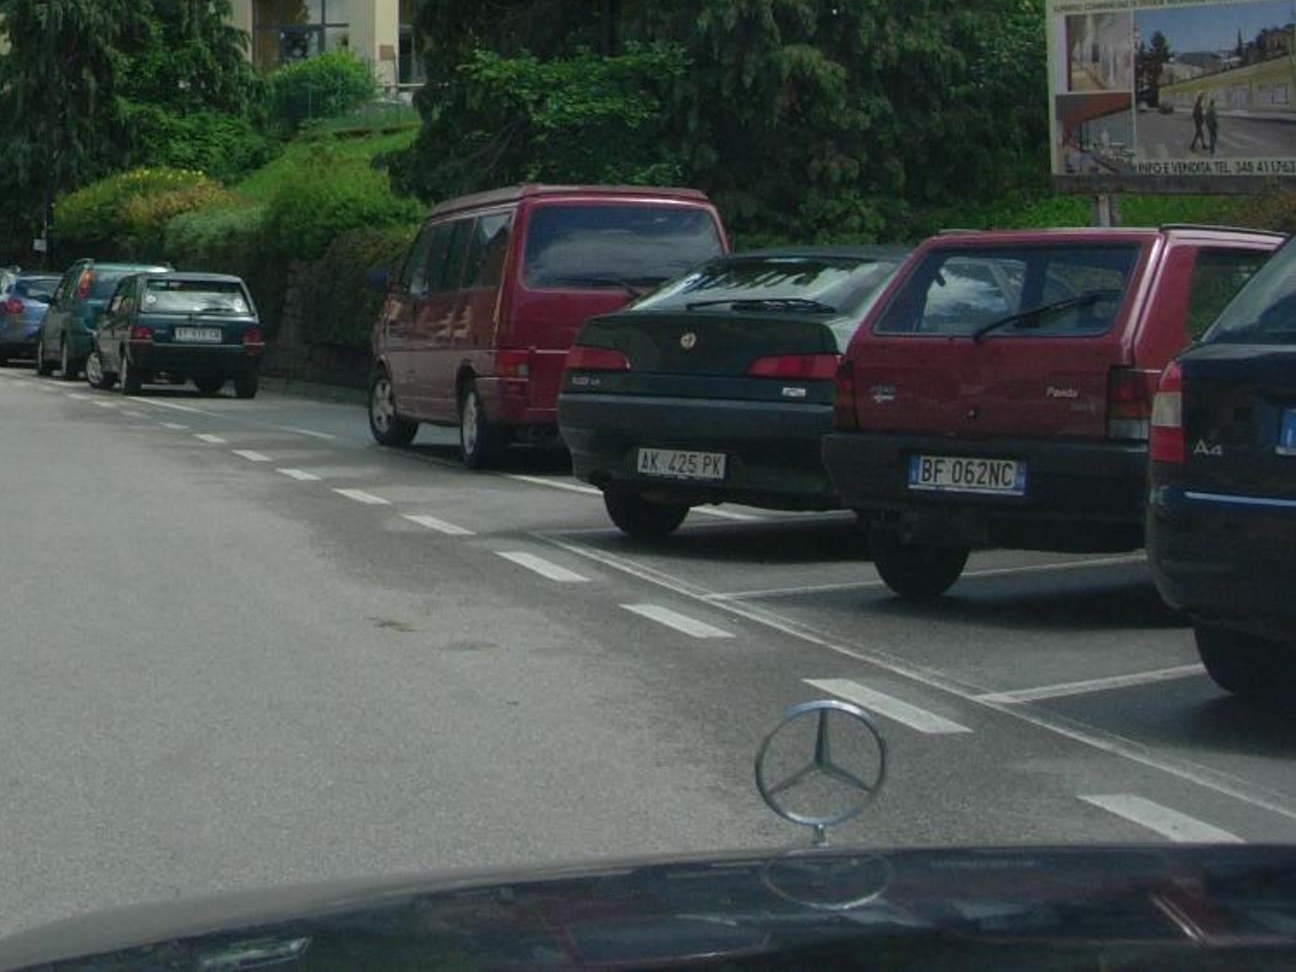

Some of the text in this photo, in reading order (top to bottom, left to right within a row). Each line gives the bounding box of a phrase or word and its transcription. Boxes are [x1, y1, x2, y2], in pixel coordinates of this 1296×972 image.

[1171, 160, 1212, 174] VENDITA
[640, 451, 659, 470] AK
[667, 452, 698, 474] 425
[921, 459, 946, 483] BF
